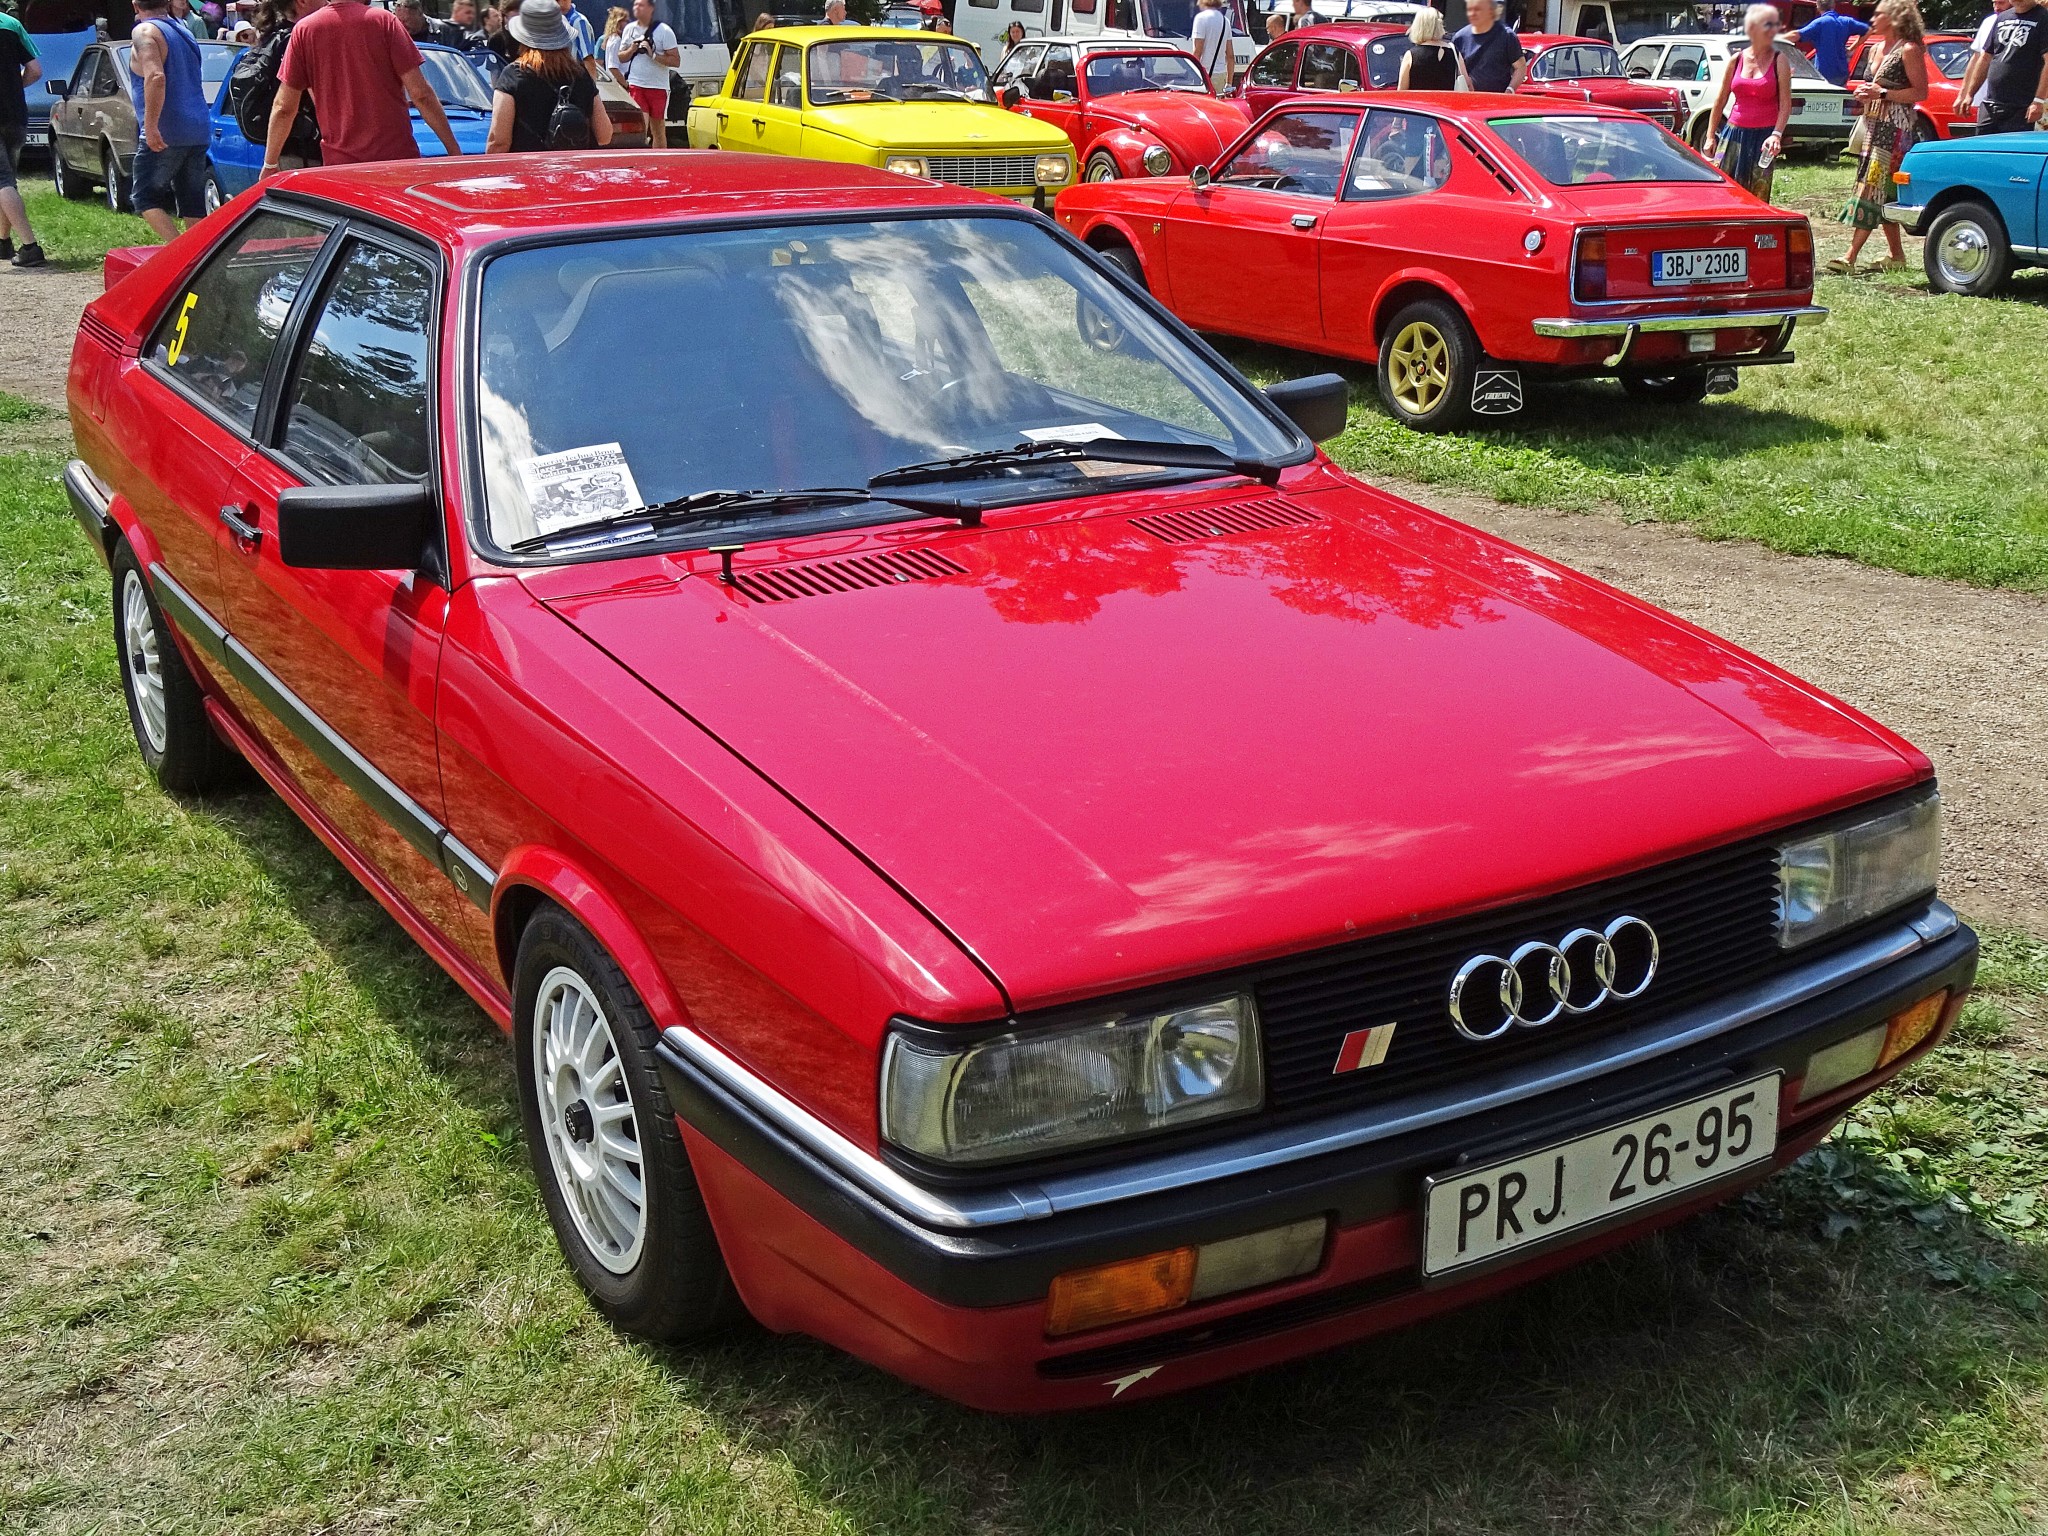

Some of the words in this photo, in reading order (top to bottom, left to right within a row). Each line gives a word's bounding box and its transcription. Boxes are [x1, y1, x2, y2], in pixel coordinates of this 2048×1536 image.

[1235, 55, 1250, 64] ULT
[1666, 254, 1694, 277] 3BJ
[1704, 252, 1740, 275] 2308
[168, 291, 199, 367] 5
[1457, 1155, 1565, 1254] PRJ
[1609, 1090, 1756, 1202] 26-95
